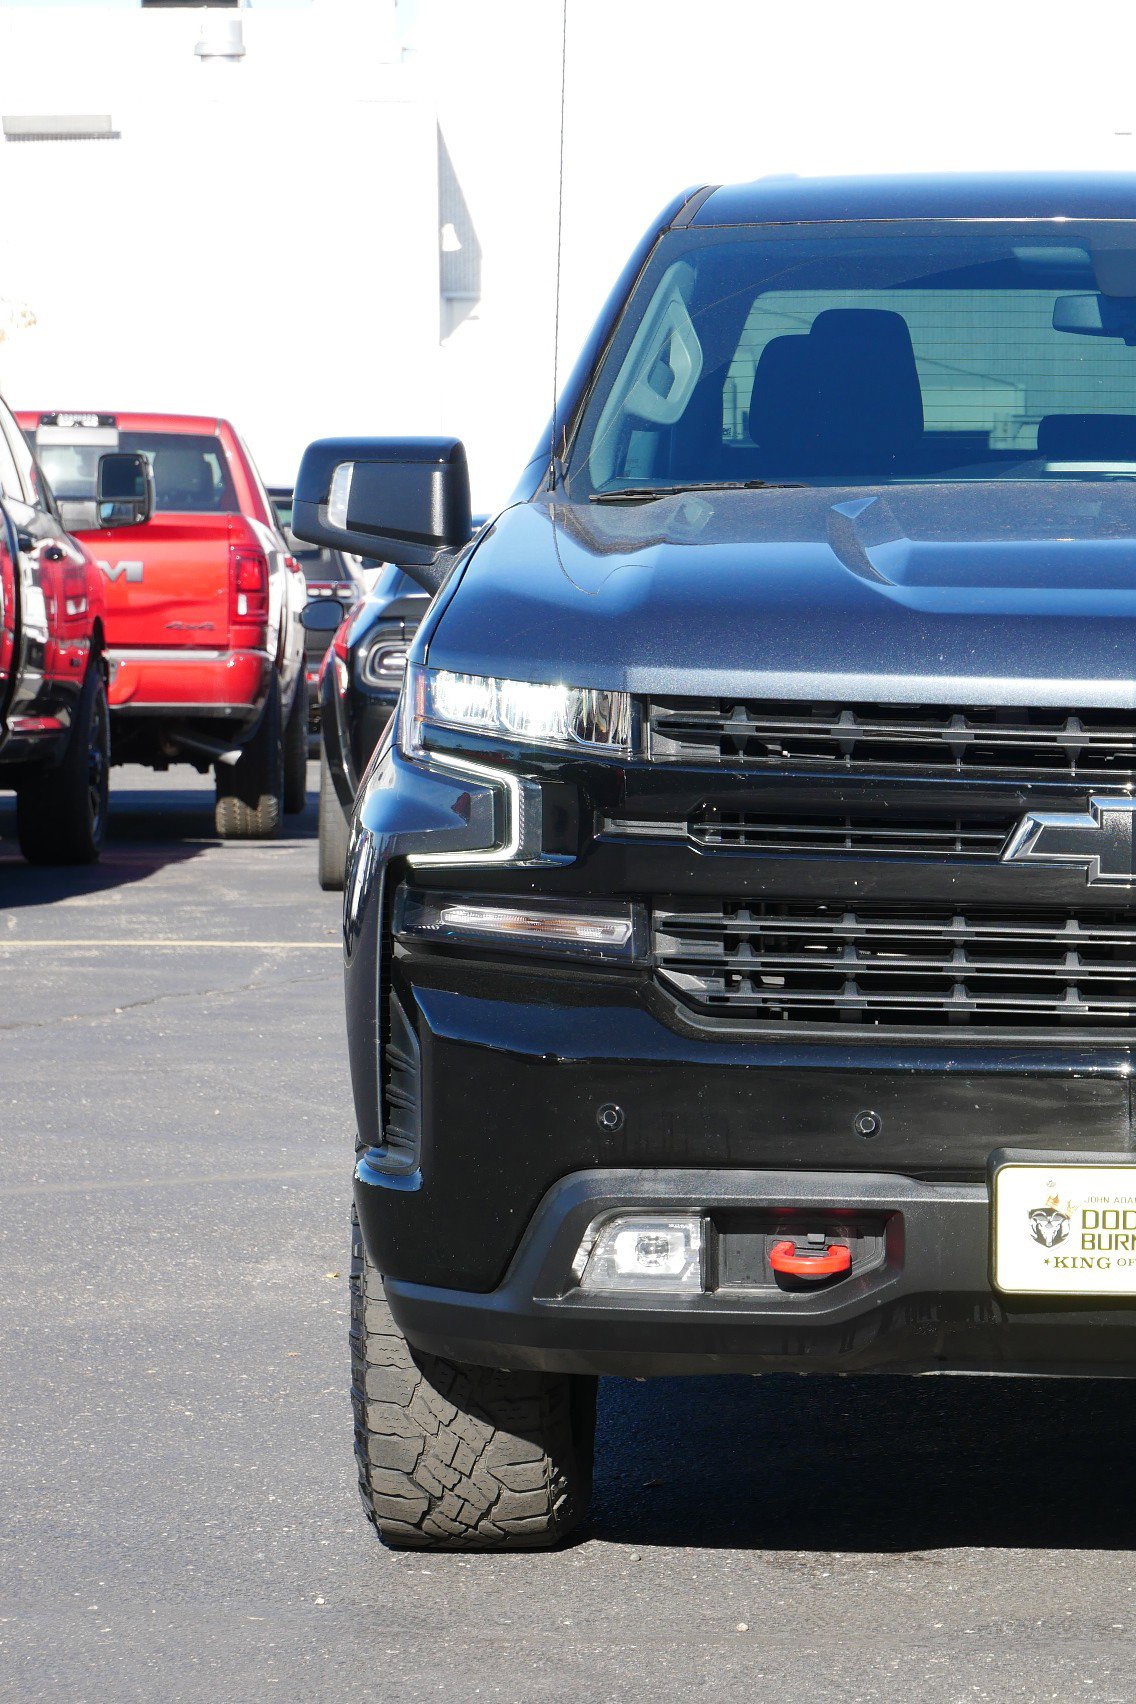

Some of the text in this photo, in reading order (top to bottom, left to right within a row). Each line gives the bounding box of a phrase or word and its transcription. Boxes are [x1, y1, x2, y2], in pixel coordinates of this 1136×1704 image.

[1084, 1196, 1110, 1204] JOHN
[1053, 1256, 1112, 1270] KING
[1117, 1257, 1136, 1267] OF
